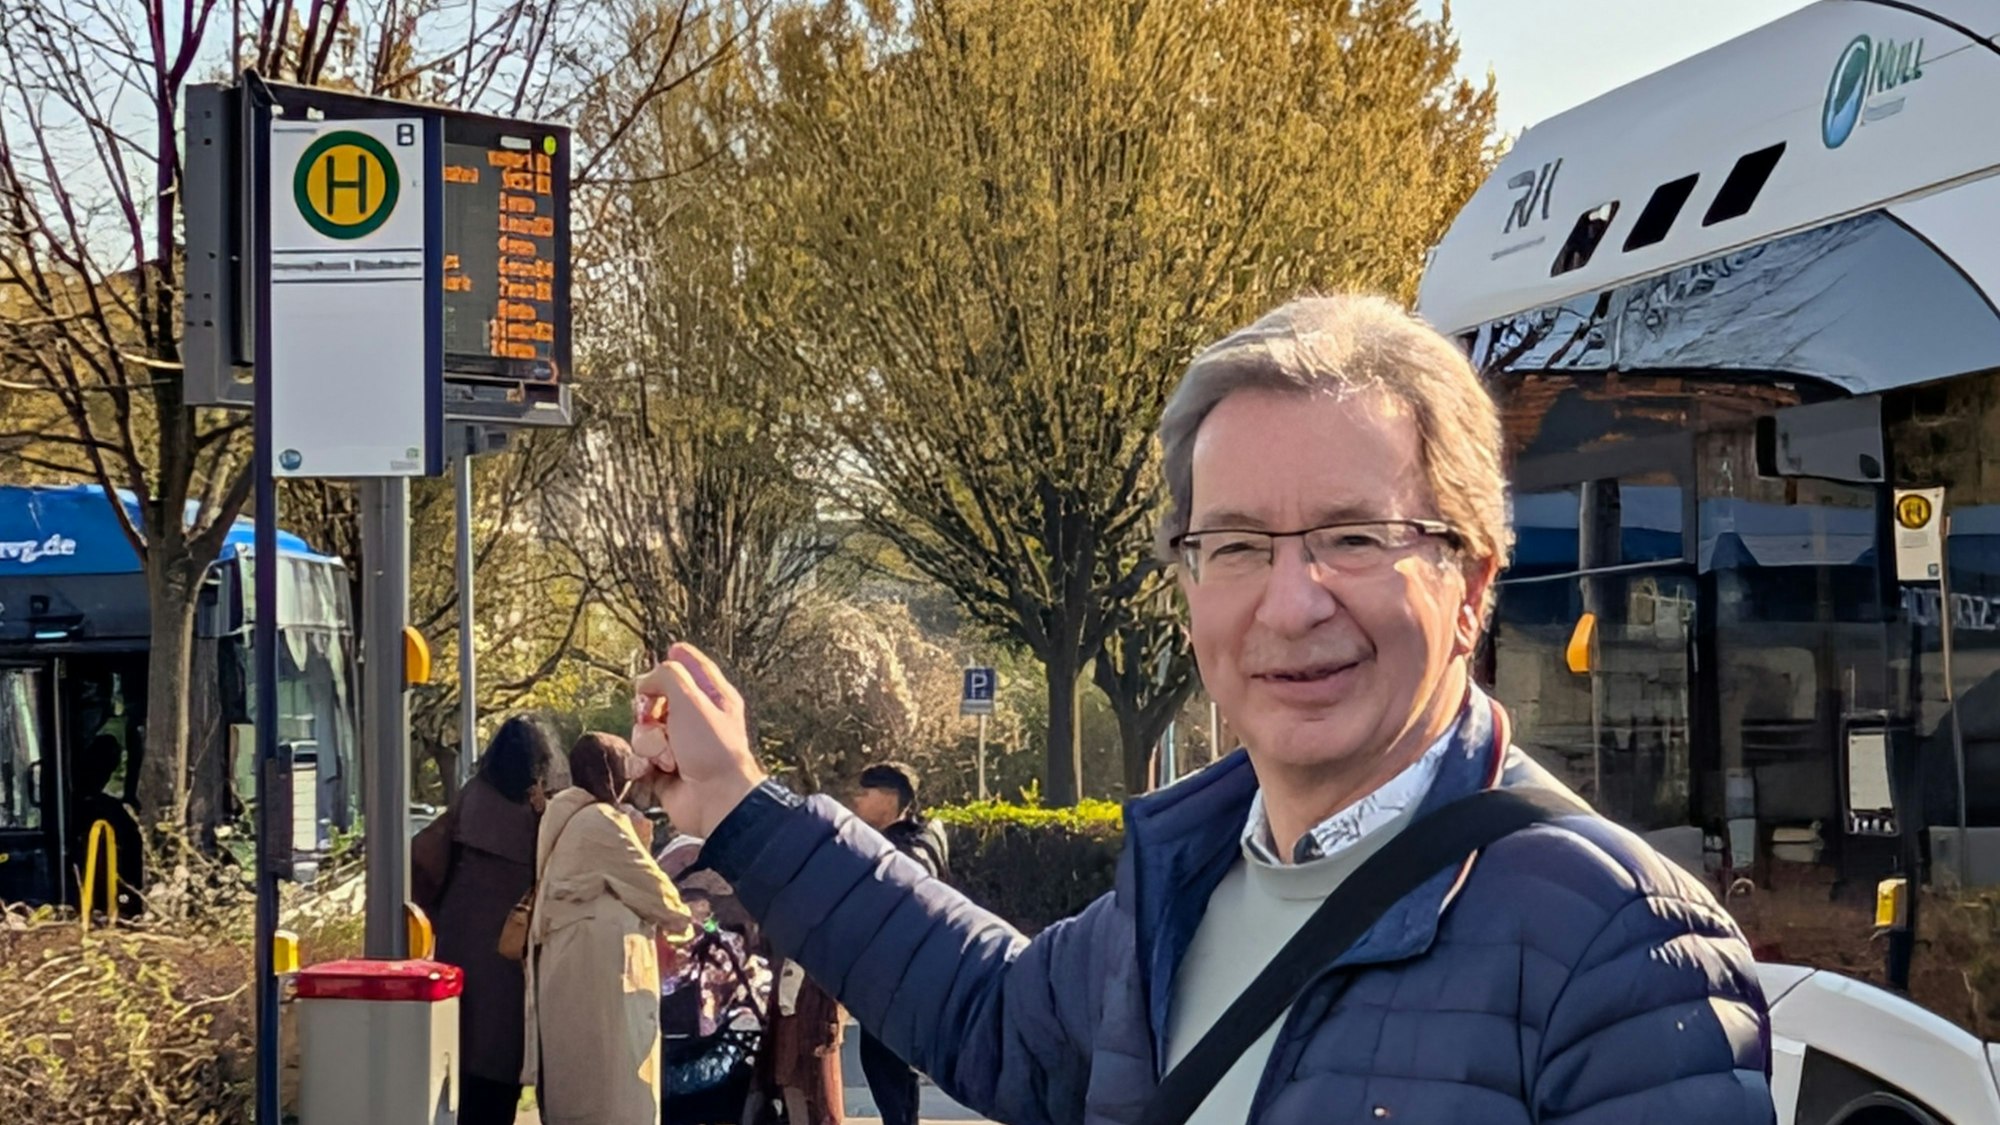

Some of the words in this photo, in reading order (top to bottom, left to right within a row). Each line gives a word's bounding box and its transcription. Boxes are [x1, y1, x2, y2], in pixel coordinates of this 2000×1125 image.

[397, 123, 414, 146] B
[326, 154, 367, 215] H
[971, 673, 988, 699] P
